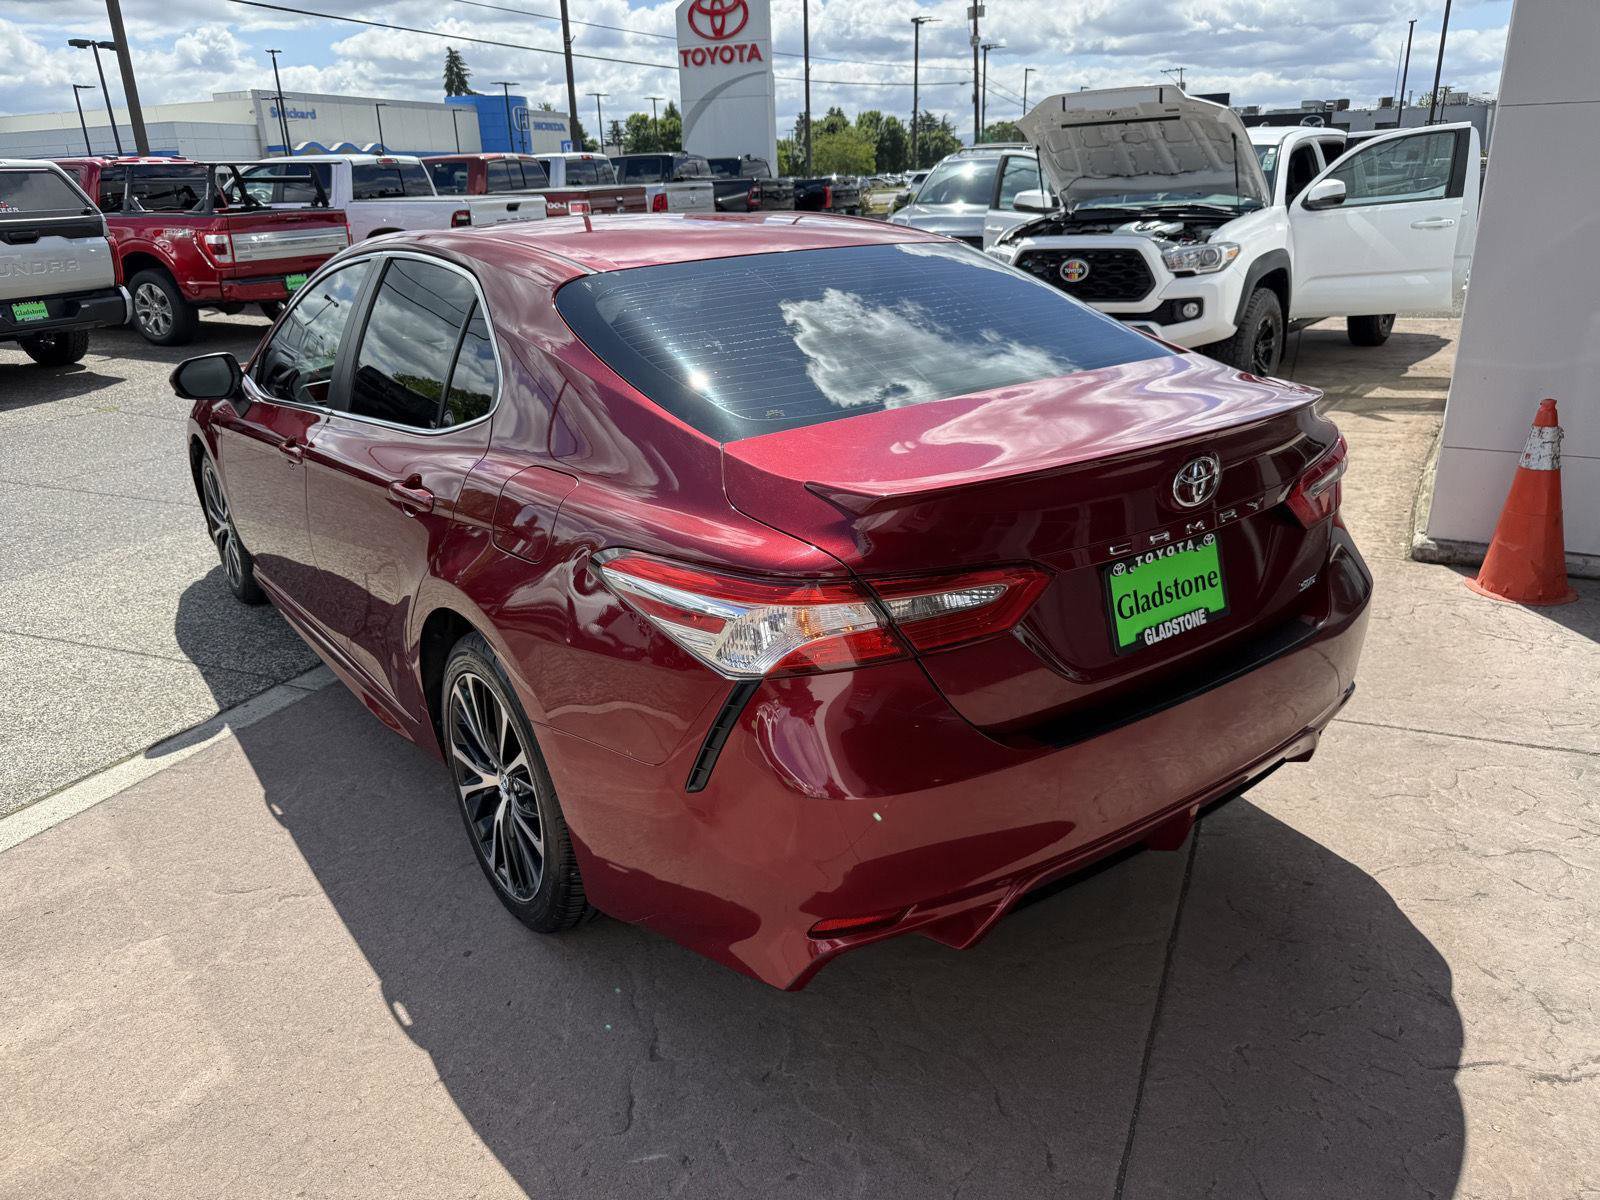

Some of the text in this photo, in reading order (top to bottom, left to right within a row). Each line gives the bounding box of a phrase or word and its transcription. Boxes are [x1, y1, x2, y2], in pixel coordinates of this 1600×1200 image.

[679, 43, 763, 67] TOYOTA
[533, 121, 566, 131] HONDA
[1109, 497, 1263, 556] CAMRY
[1135, 539, 1195, 568] TOYOTA
[1117, 569, 1219, 620] Gladstone
[1144, 607, 1207, 645] GLADSTONE
